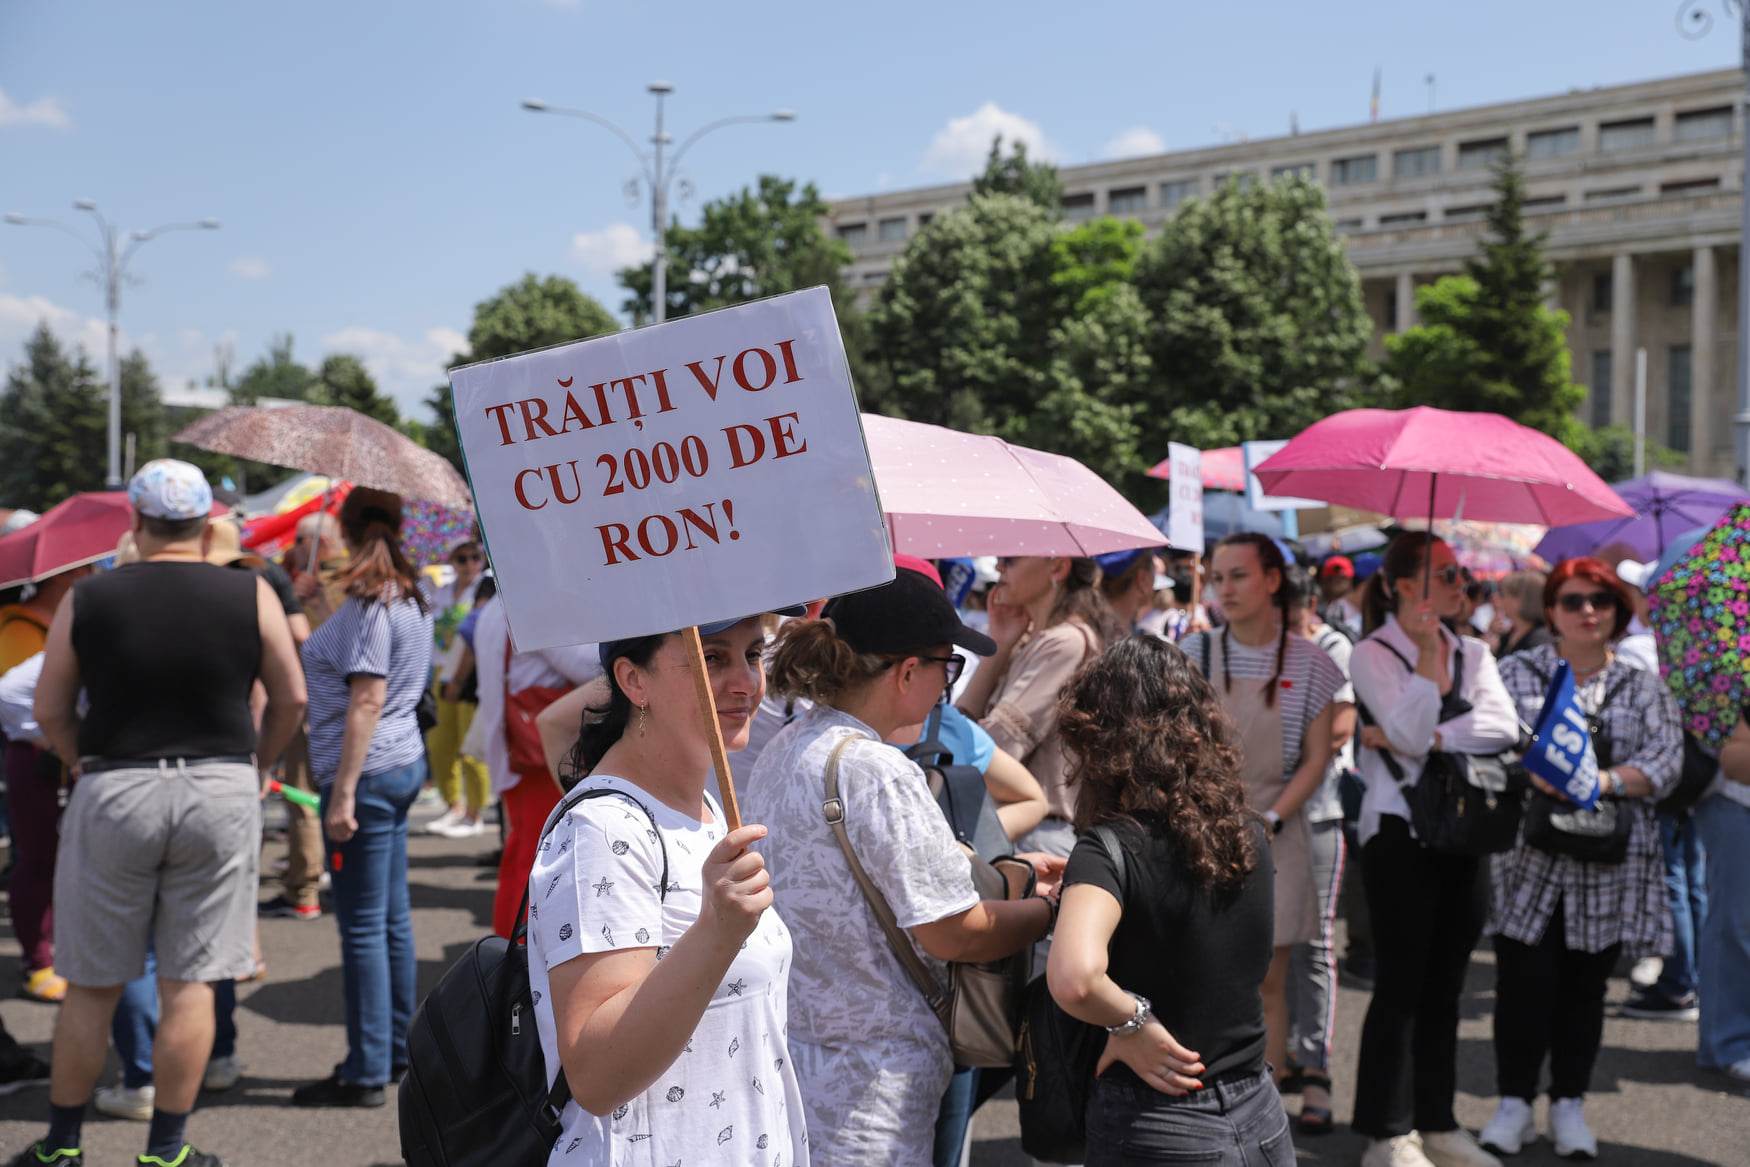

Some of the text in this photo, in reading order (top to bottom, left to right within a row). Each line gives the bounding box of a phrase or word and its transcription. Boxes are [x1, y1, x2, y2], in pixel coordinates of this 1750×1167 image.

[485, 339, 805, 447] TRĂIȚI VOI
[514, 411, 808, 511] CU 2000 DE
[594, 498, 741, 566] RON!
